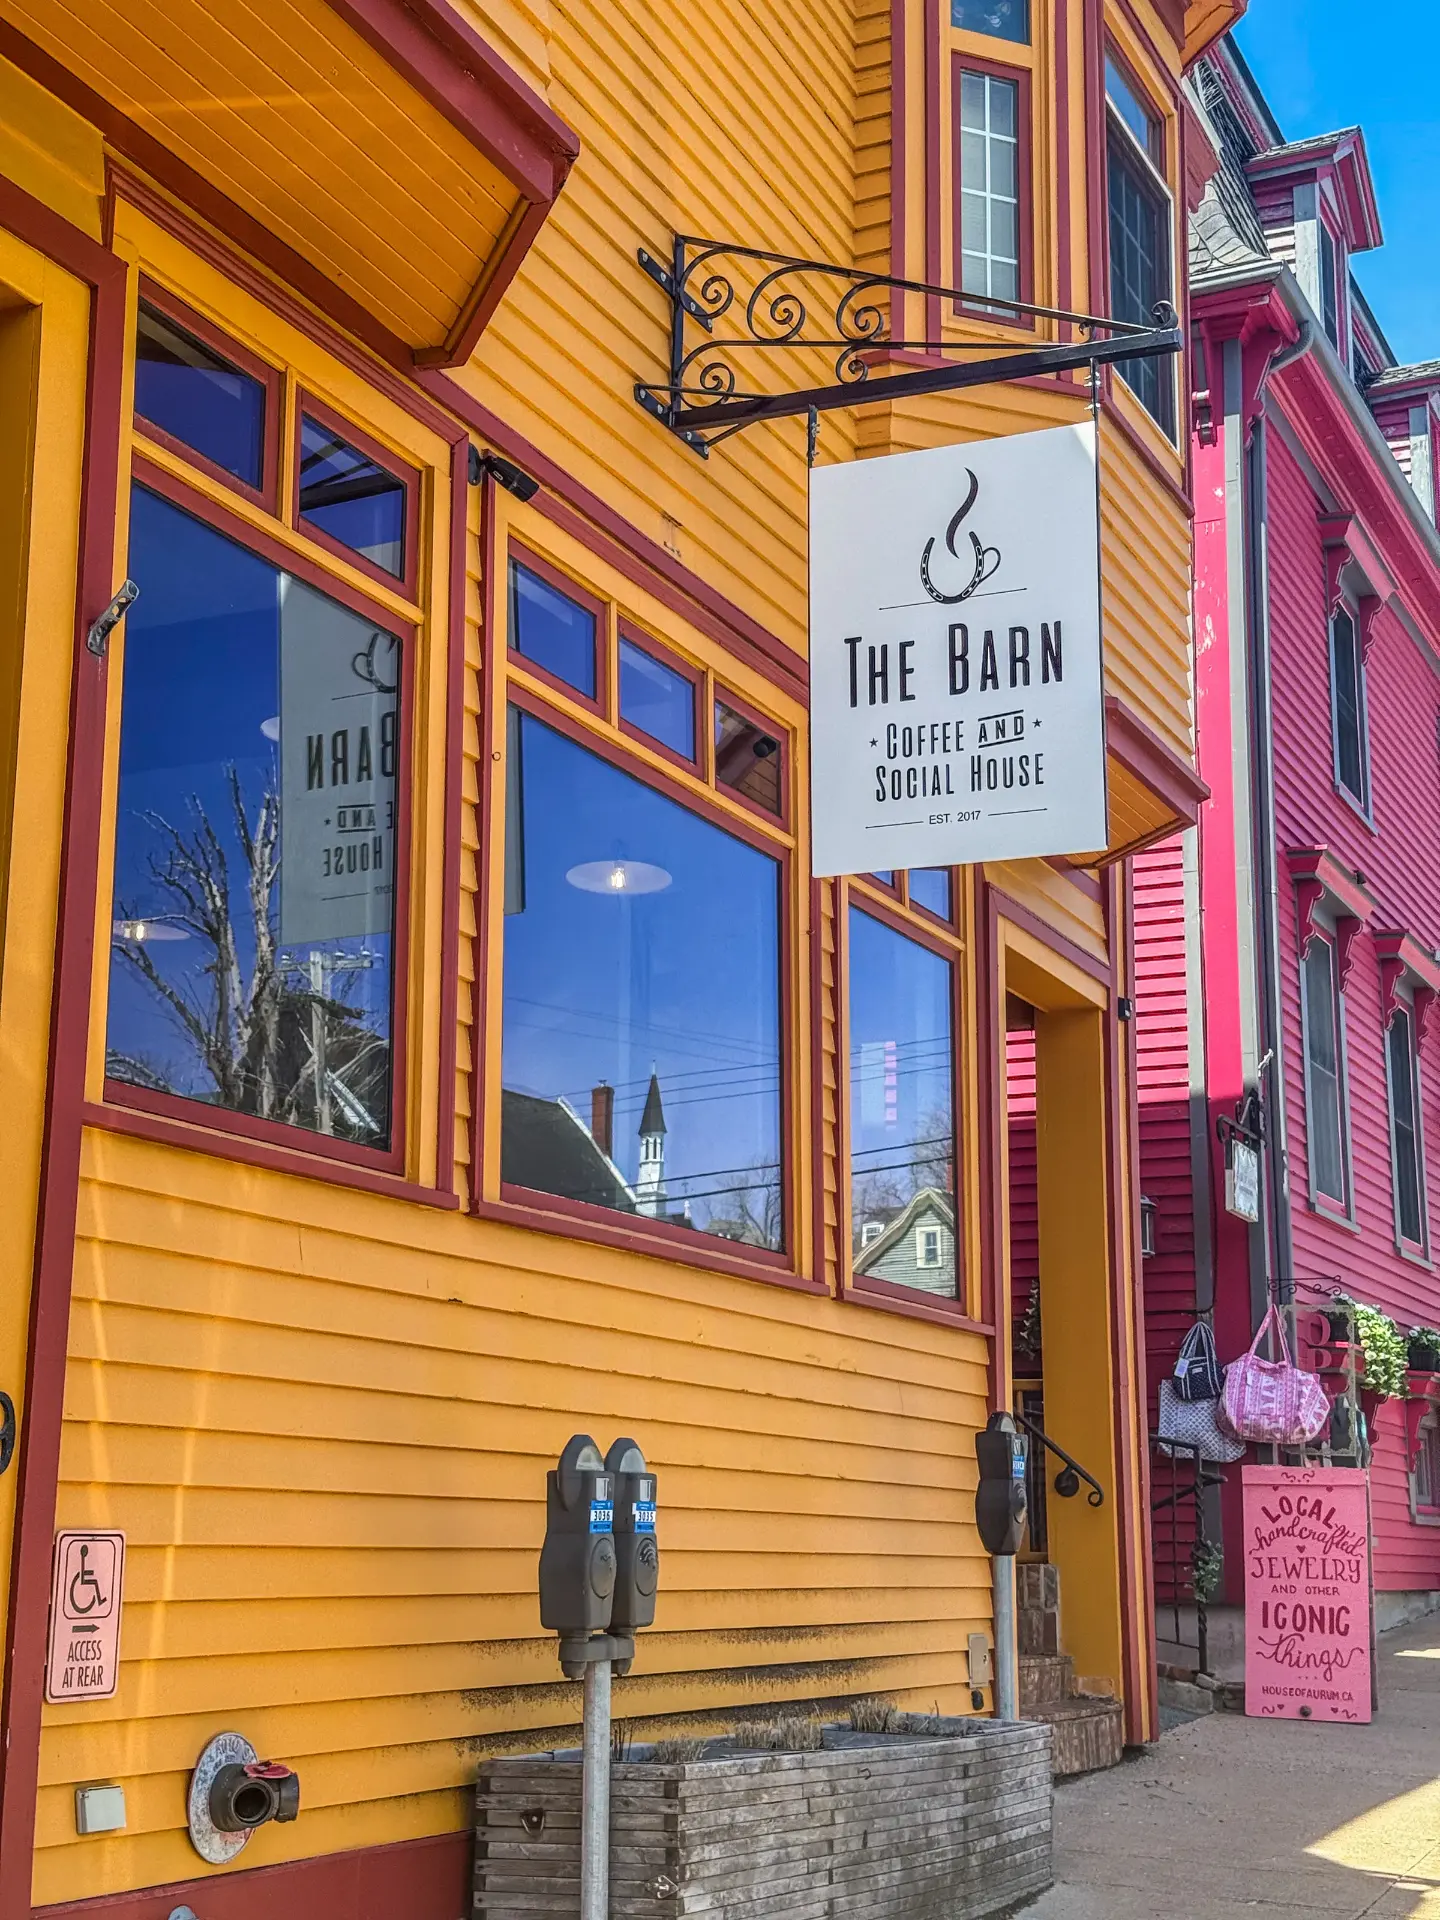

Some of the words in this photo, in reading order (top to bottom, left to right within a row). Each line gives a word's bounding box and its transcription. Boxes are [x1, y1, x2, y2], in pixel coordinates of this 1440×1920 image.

[843, 636, 917, 708] THE
[947, 620, 1064, 696] BARN
[886, 720, 965, 760] COFFEE
[978, 713, 1025, 744] AND
[874, 762, 955, 803] SOCIAL
[970, 752, 1045, 793] HOUSE
[928, 812, 953, 826] EST.
[956, 810, 981, 823] 2017
[593, 1510, 611, 1521] 3036
[1261, 1495, 1336, 1529] LOCAL
[1249, 1515, 1366, 1558] handcrafted
[1251, 1556, 1360, 1584] JEWELRY
[1271, 1584, 1297, 1594] AND
[1305, 1586, 1340, 1596] OTHER
[1262, 1600, 1350, 1637] ICONIC
[67, 1640, 102, 1662] ACCESS
[1256, 1633, 1364, 1682] things
[62, 1667, 75, 1688] AT
[77, 1665, 104, 1687] REAR
